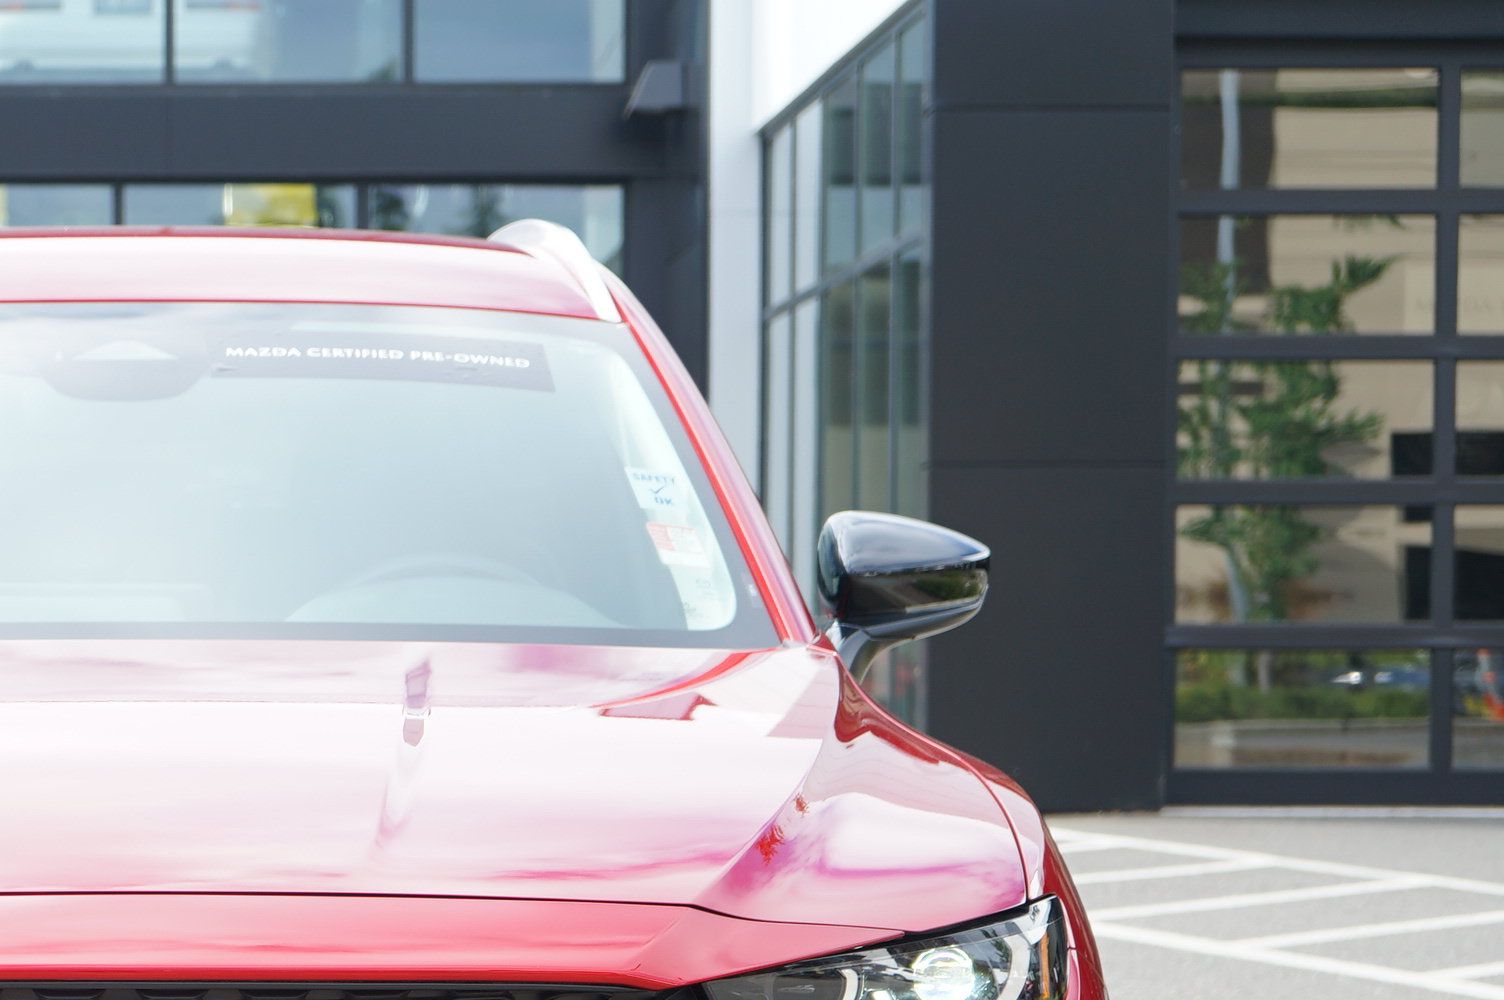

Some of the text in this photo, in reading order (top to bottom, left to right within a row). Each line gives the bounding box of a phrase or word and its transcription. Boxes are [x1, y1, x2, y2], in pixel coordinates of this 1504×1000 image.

[225, 346, 530, 367] MAZDA CERTIFIED PRE-OWNED
